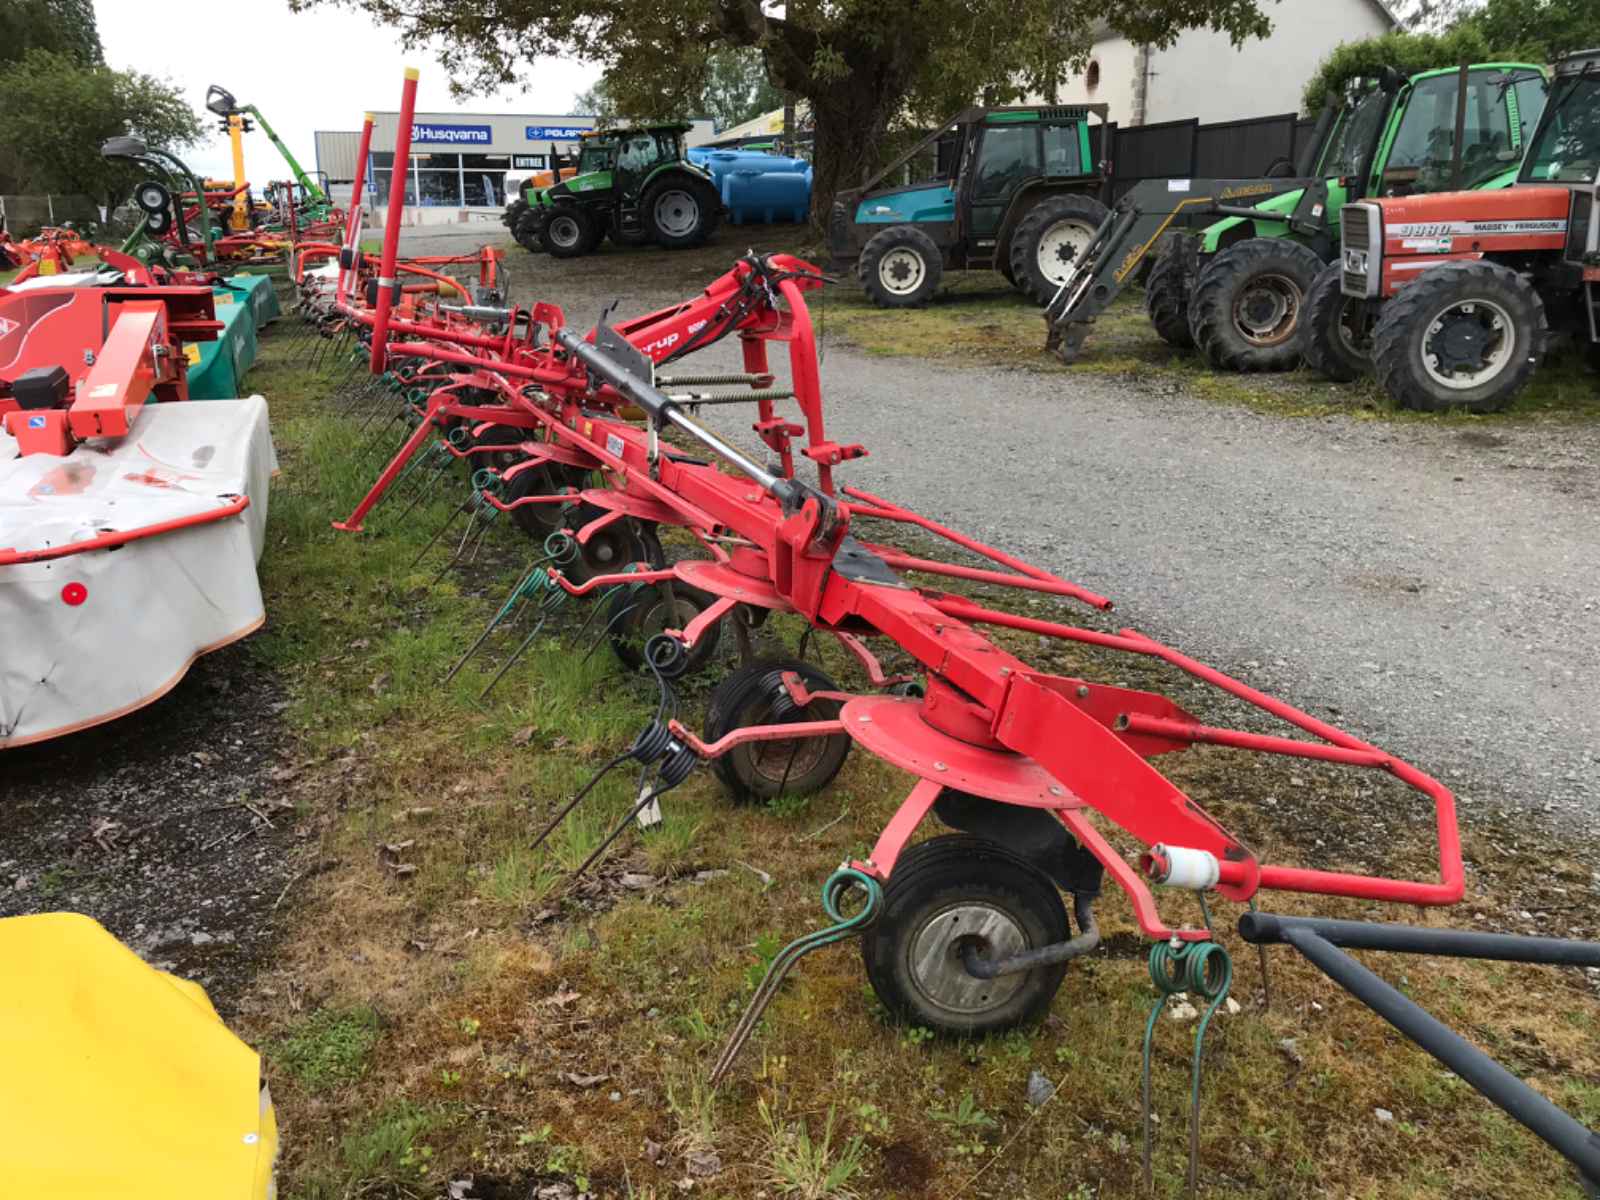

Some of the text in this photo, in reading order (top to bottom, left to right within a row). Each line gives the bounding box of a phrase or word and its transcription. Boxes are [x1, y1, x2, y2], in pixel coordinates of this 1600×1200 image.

[420, 128, 488, 141] Husqvarna
[1473, 223, 1508, 231] MASSEY
[1515, 222, 1560, 230] FERGUSON
